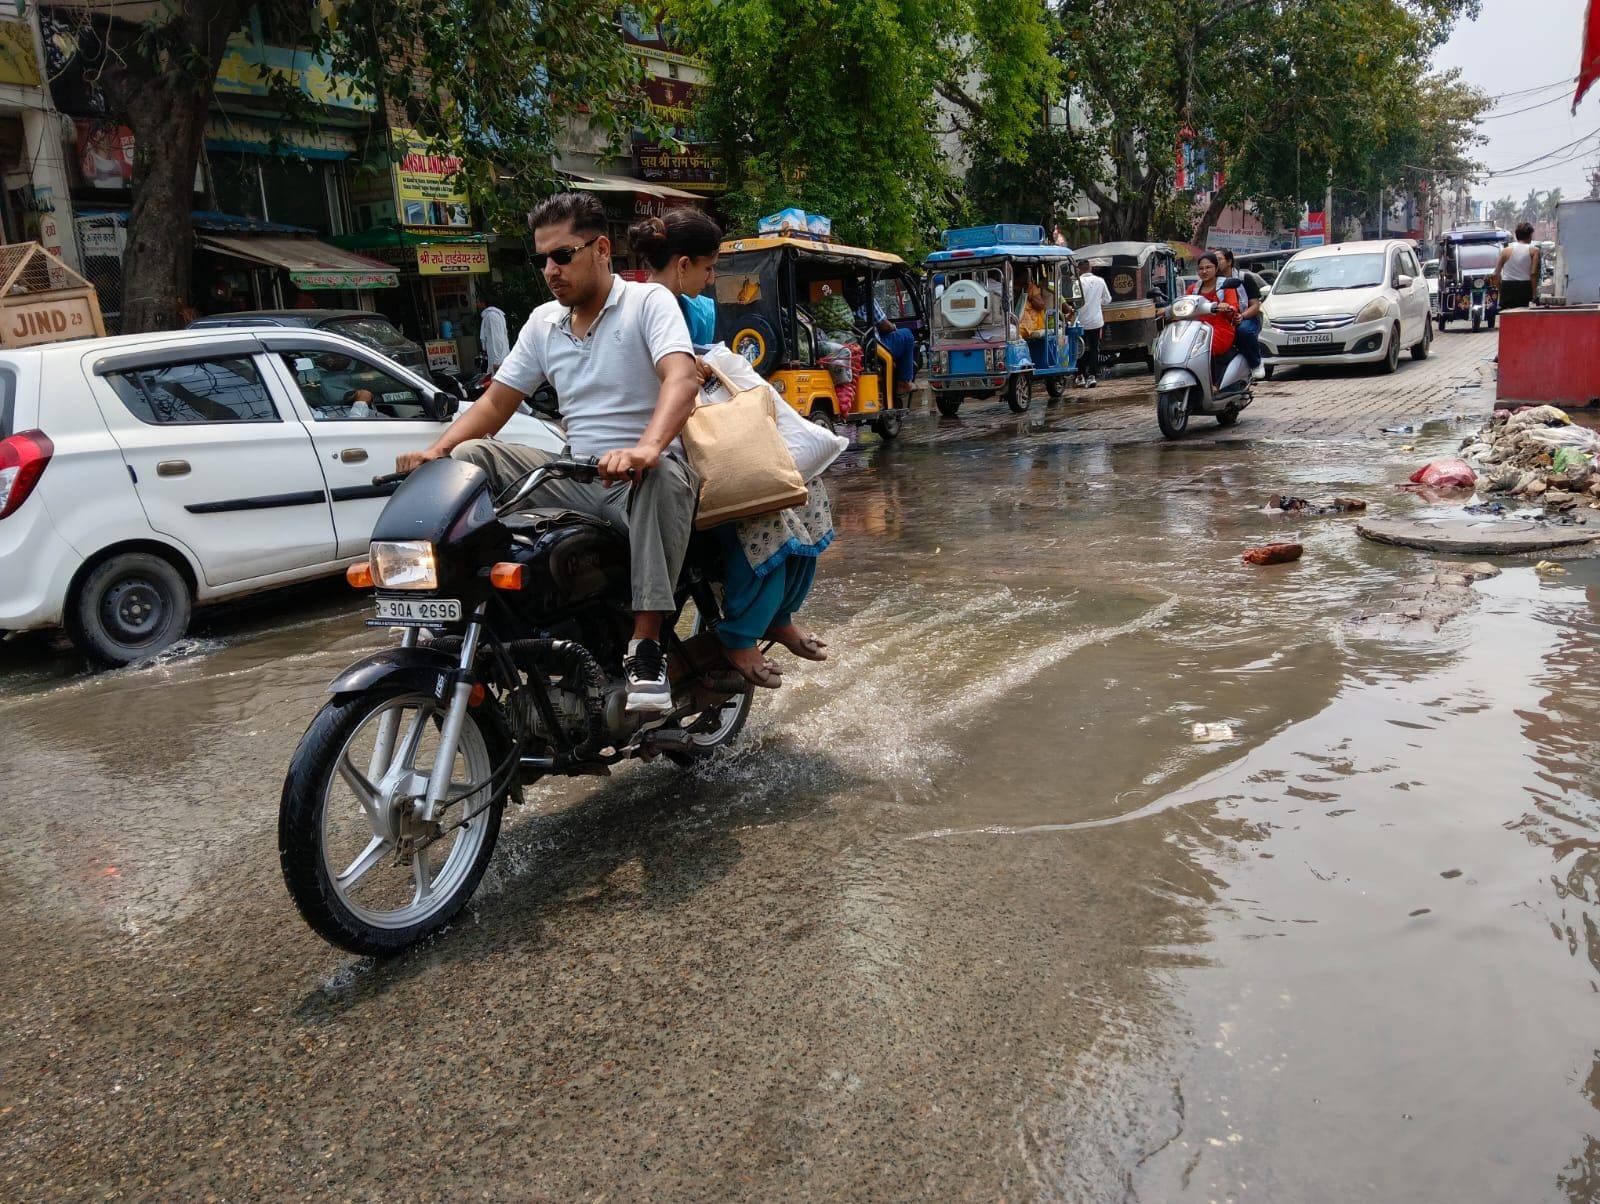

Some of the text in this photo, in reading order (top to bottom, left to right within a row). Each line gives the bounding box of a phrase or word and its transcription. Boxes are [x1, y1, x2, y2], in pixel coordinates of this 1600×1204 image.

[658, 152, 670, 168] श्री
[671, 156, 688, 168] राम
[420, 250, 430, 265] श्री
[431, 251, 443, 264] राधे
[472, 252, 486, 264] स्टोर
[12, 309, 67, 337] JIND
[1293, 336, 1301, 344] HR
[420, 603, 457, 618] 2696
